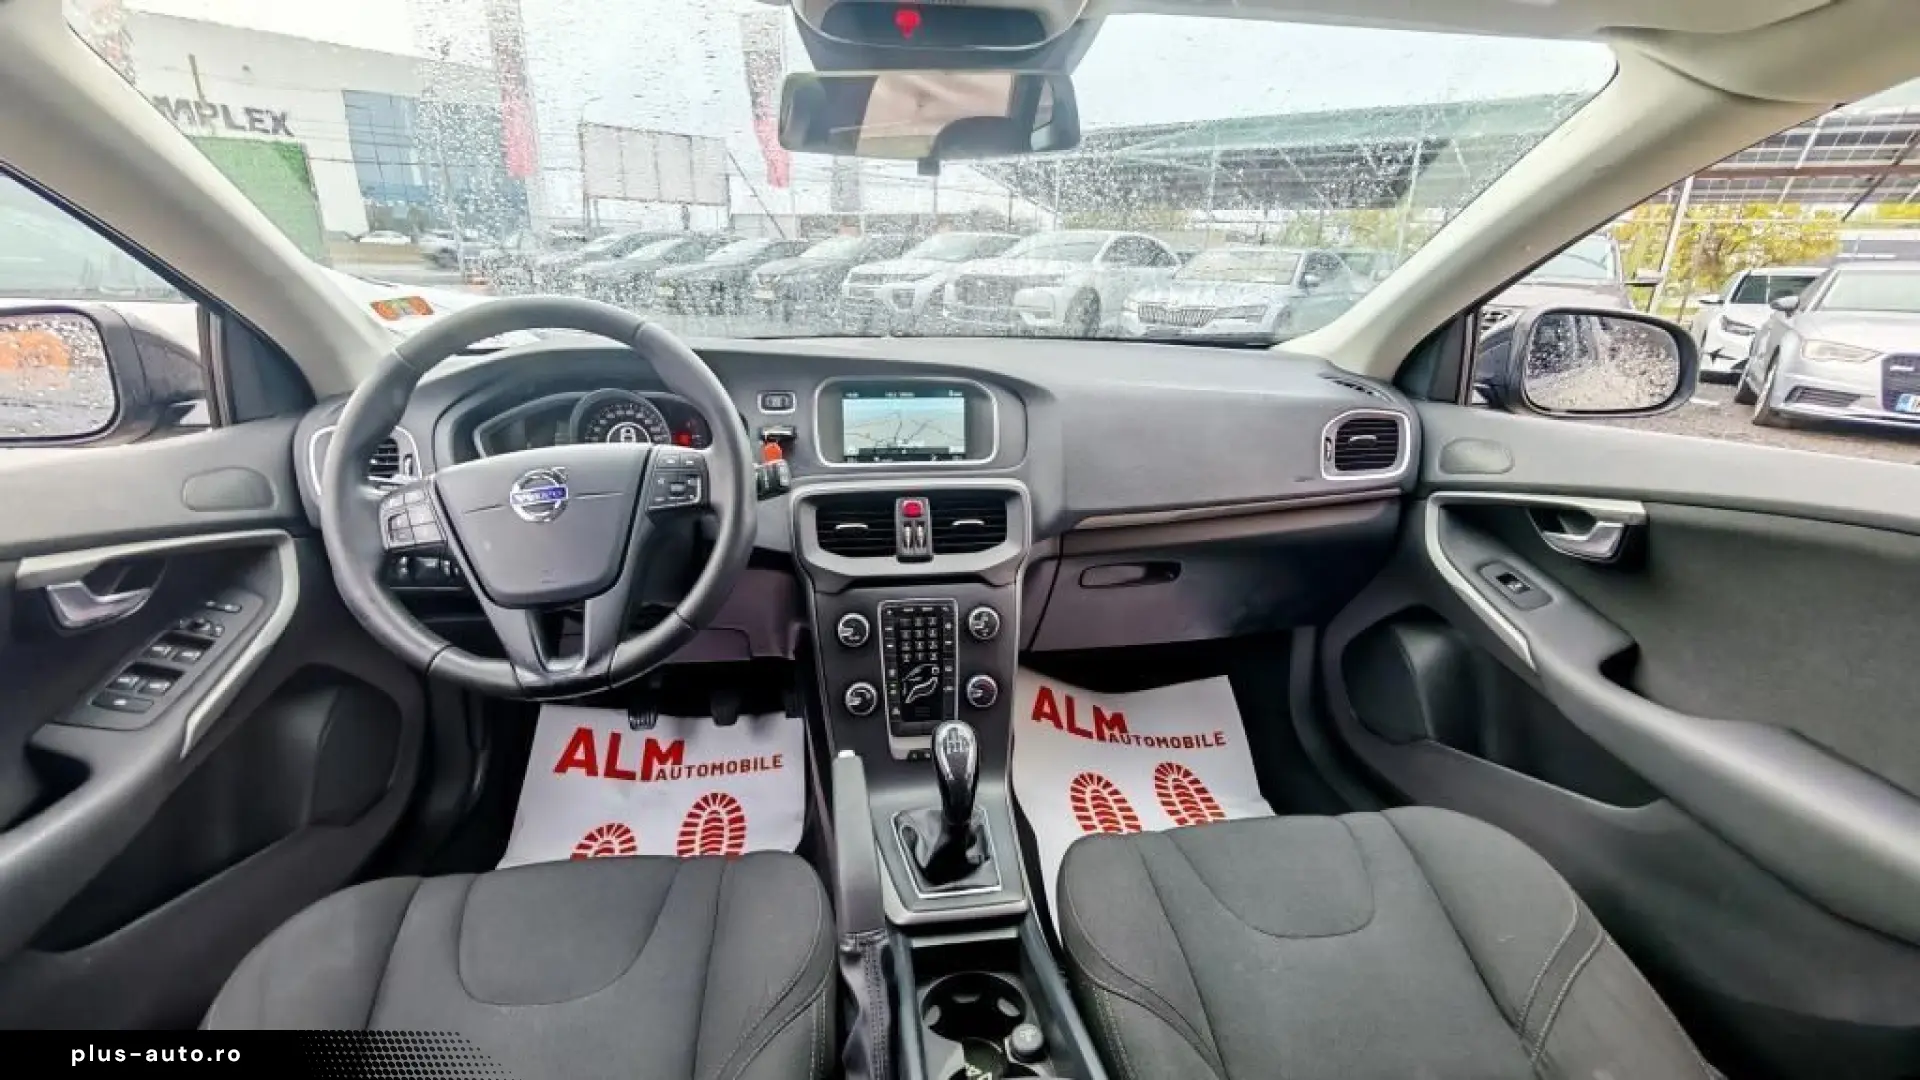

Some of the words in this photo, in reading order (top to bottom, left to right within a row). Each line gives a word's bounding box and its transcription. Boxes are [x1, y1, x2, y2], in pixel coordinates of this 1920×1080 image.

[1031, 685, 1129, 742] ALM
[1109, 731, 1227, 749] AUTOMOBILE
[554, 727, 685, 782] ALM
[655, 754, 784, 781] AUTOMOBILE
